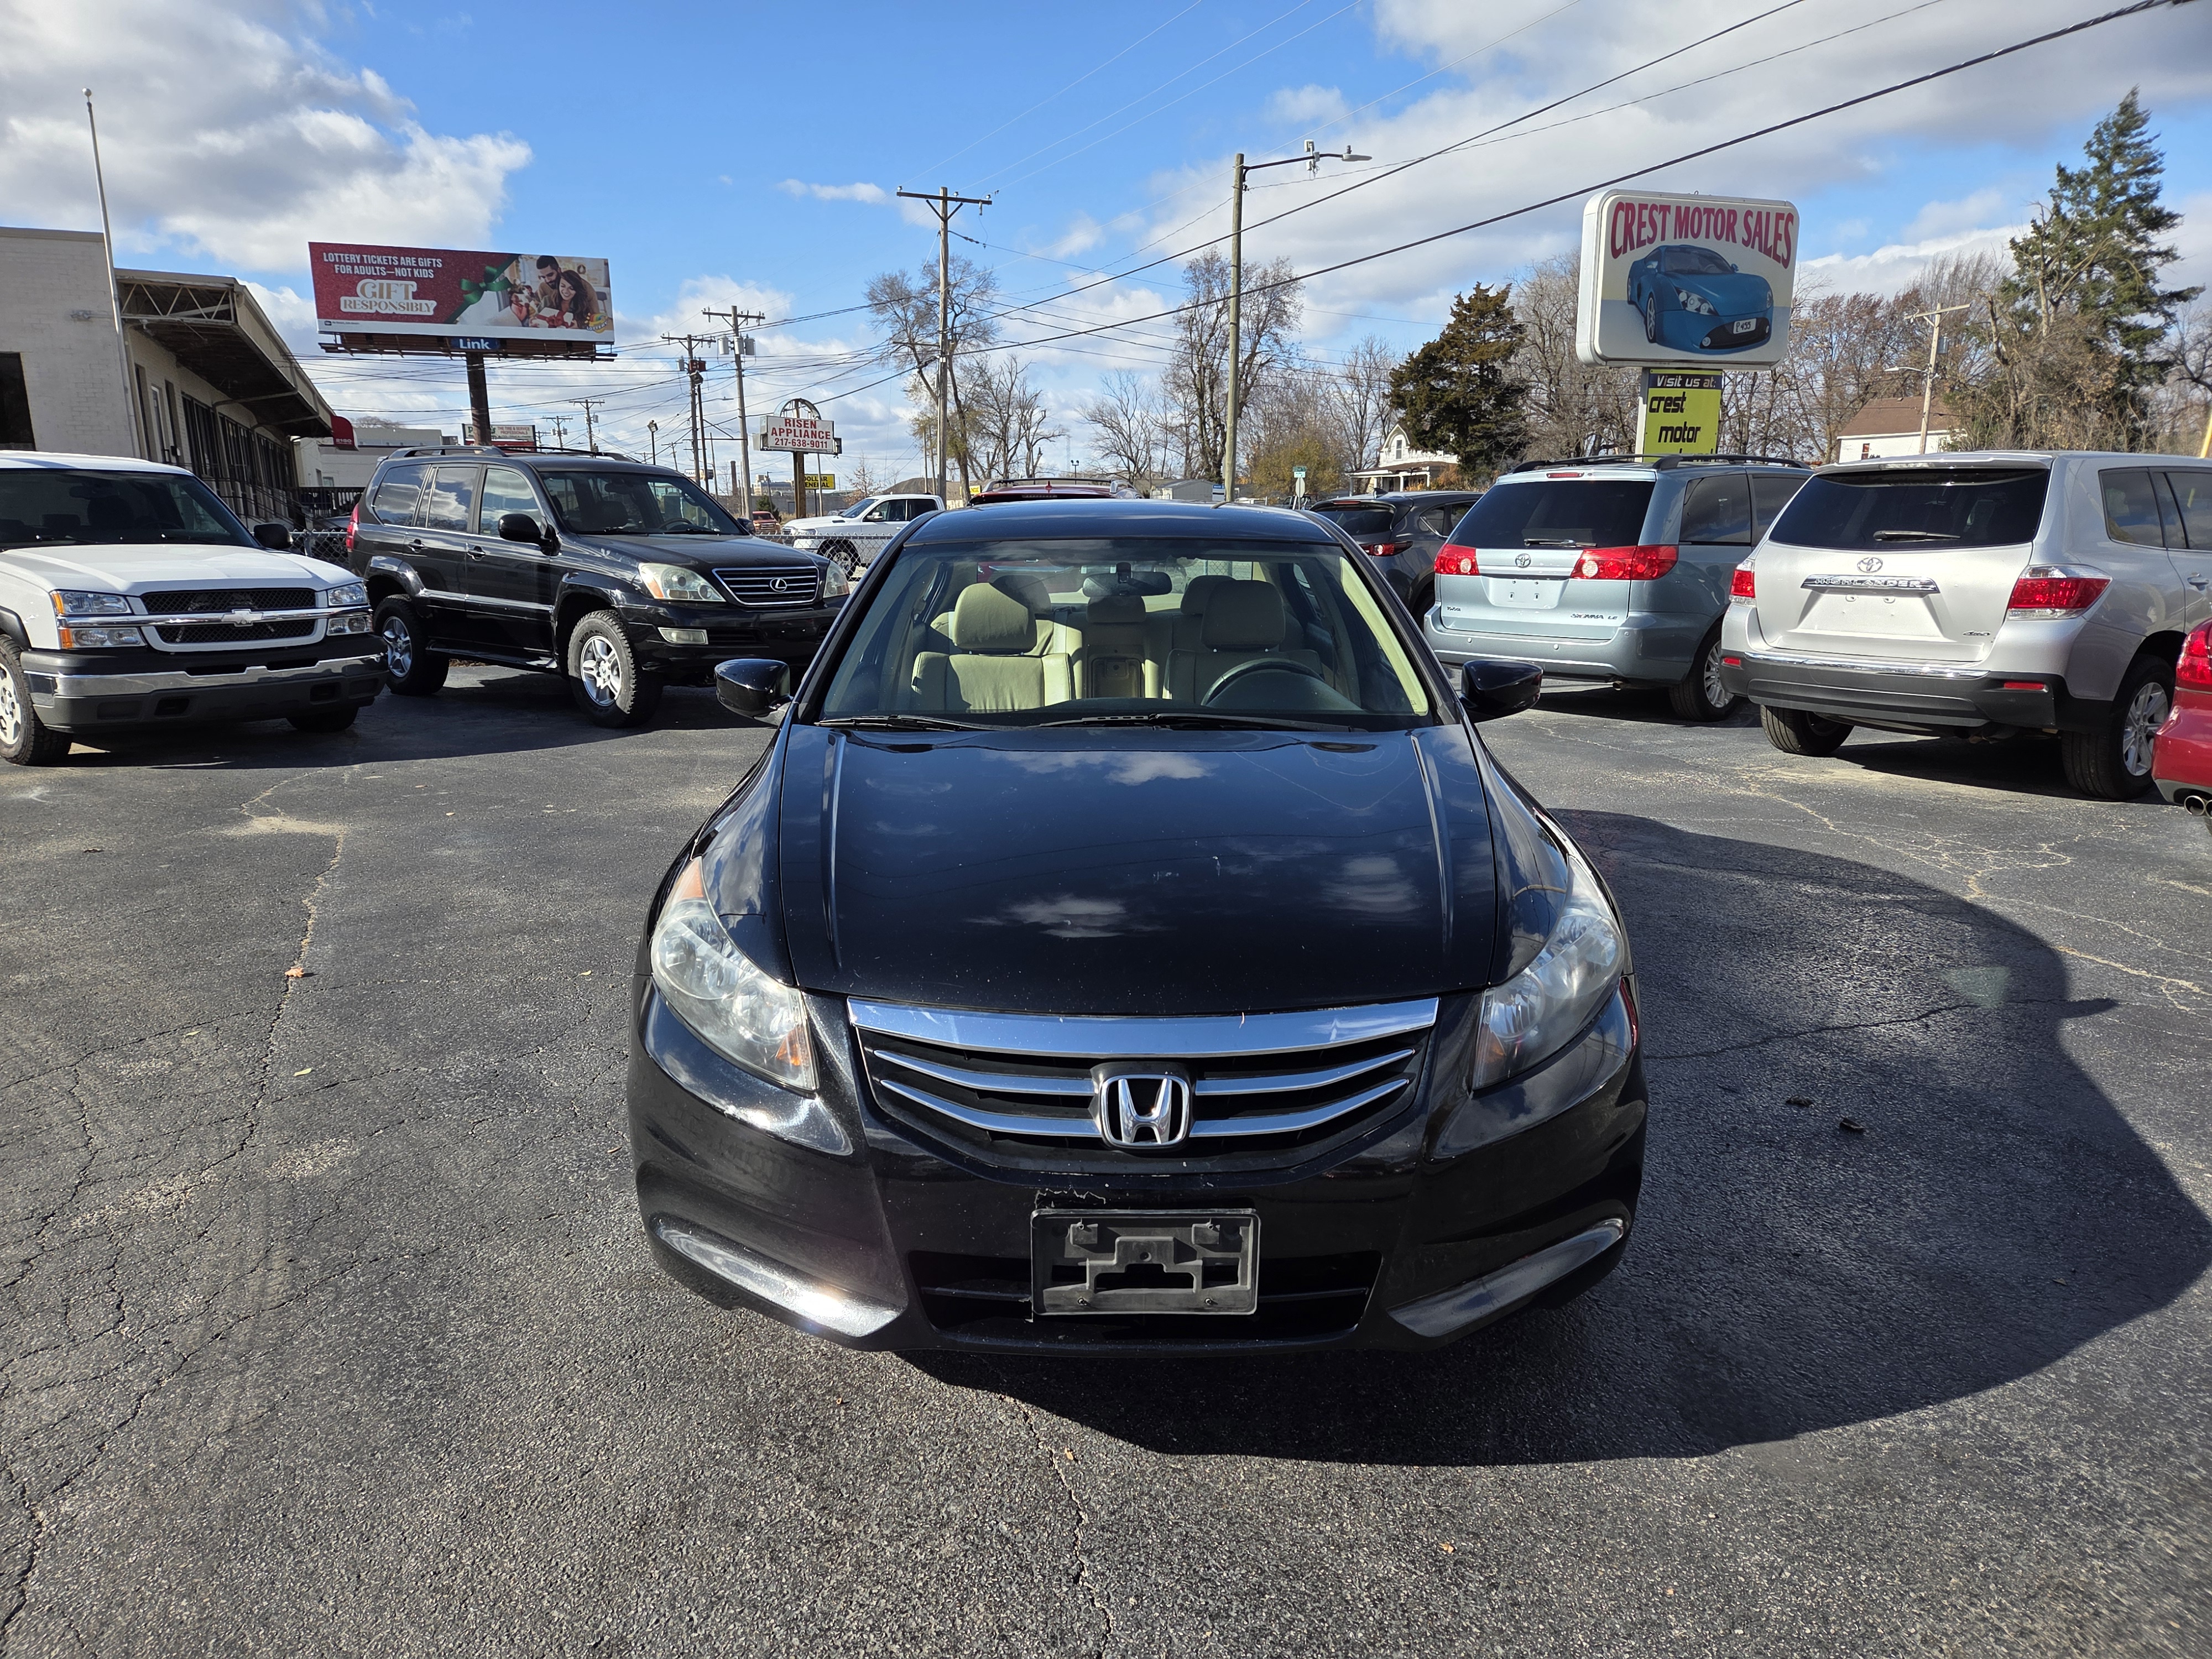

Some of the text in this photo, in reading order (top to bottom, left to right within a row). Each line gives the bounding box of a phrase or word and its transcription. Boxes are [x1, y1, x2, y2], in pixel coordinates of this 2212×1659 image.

[1611, 201, 1794, 269] CREST MOTOR SALES
[324, 253, 442, 268] LOTTERY TICKETS ARE GIFTS
[335, 264, 352, 274] FOR
[414, 268, 434, 278] KIDS
[360, 282, 414, 300] GIFT
[343, 299, 434, 312] RESPONSIBLY
[459, 338, 490, 349] Link
[1656, 375, 1682, 387] Visit
[1685, 377, 1700, 387] us
[1648, 392, 1687, 413] crest
[785, 419, 817, 429] RISEN
[771, 427, 831, 439] APPLIANCE
[1658, 421, 1701, 442] motor
[775, 438, 827, 448] 217-638-9011
